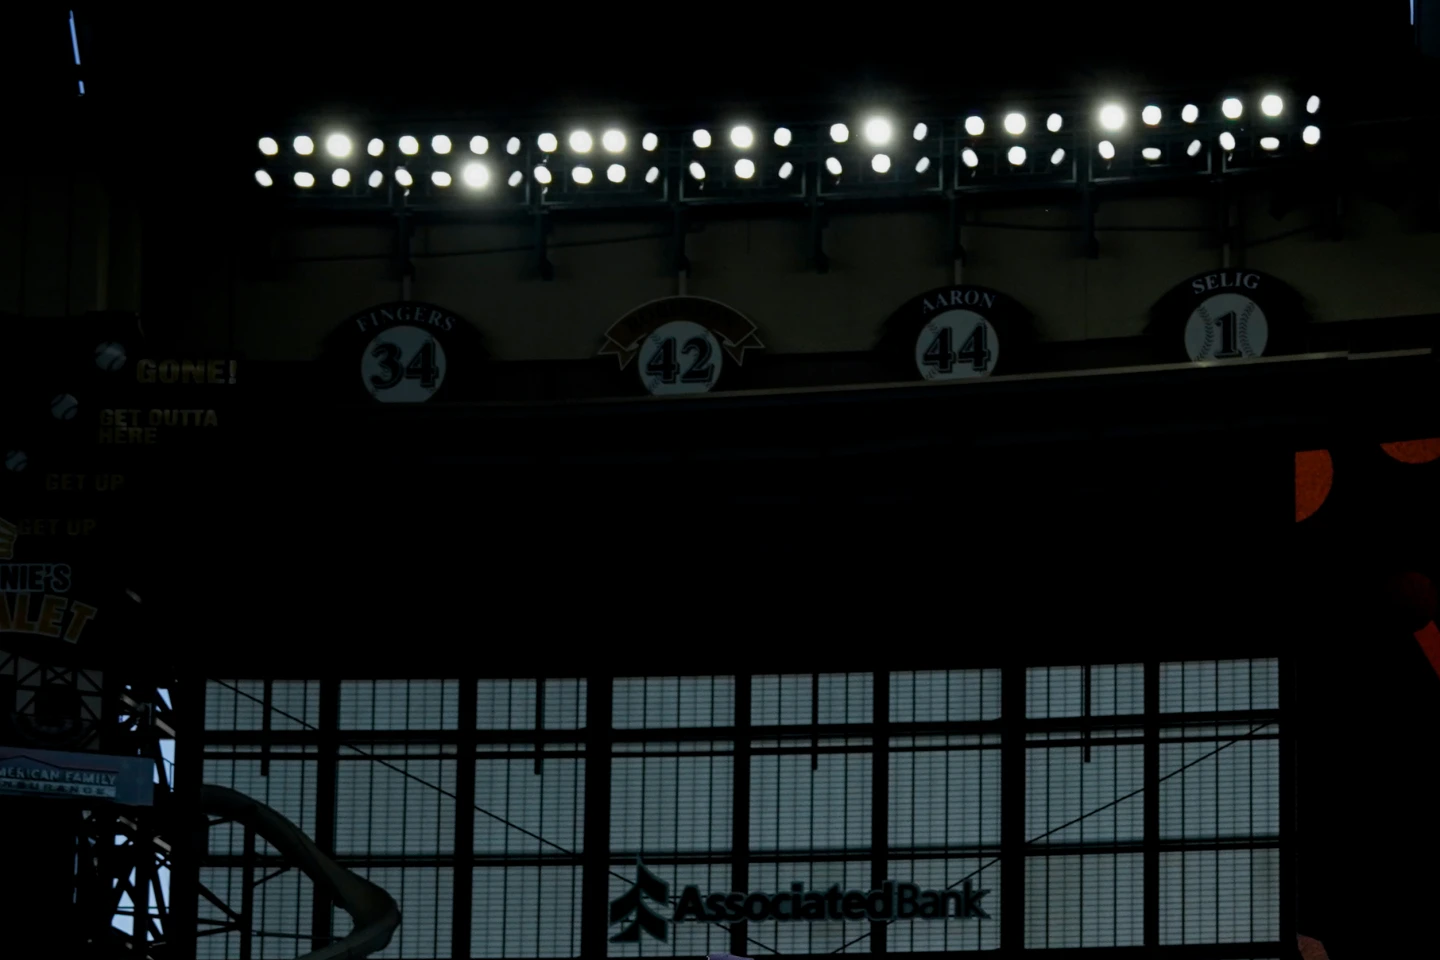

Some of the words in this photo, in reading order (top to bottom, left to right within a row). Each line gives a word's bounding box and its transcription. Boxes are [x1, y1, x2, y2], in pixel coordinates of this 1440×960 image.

[1191, 271, 1261, 295] SELIG
[920, 289, 997, 315] AARON
[355, 304, 457, 334] FINGERS
[922, 321, 991, 374] 44
[1214, 310, 1241, 359] 1
[136, 358, 238, 384] GONE!
[369, 342, 440, 390] 34
[646, 336, 714, 384] 42
[100, 408, 142, 427] GET
[148, 408, 219, 427] OUTTA
[97, 427, 158, 444] HERE
[45, 472, 88, 492] GET
[94, 473, 126, 492] UP
[17, 517, 61, 535] GET
[66, 517, 97, 536] UP
[64, 770, 117, 786] FAMILY
